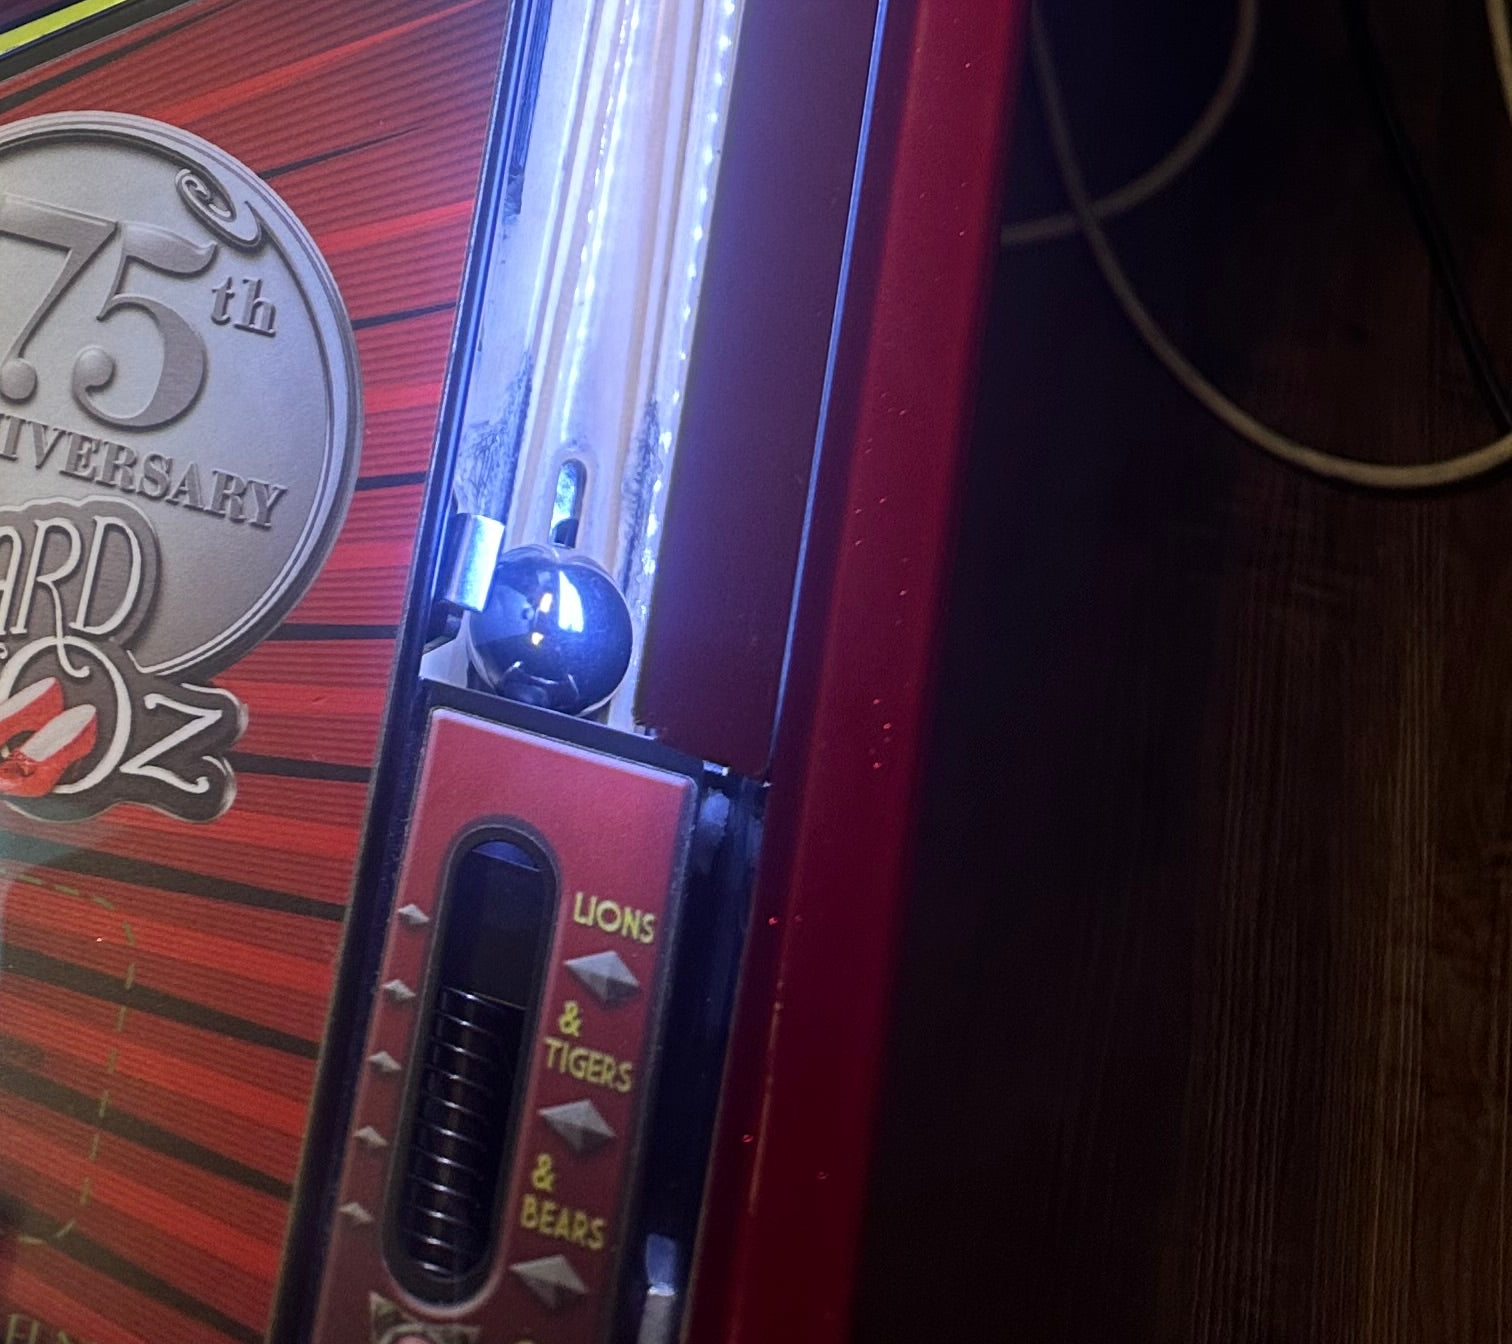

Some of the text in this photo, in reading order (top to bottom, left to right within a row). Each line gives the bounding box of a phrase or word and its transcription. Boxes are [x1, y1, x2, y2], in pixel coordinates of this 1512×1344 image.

[573, 893, 656, 944] LIONS
[558, 1000, 583, 1037] &
[543, 1038, 632, 1093] TIGERS
[531, 1153, 556, 1192] &
[520, 1195, 606, 1251] BEARS
